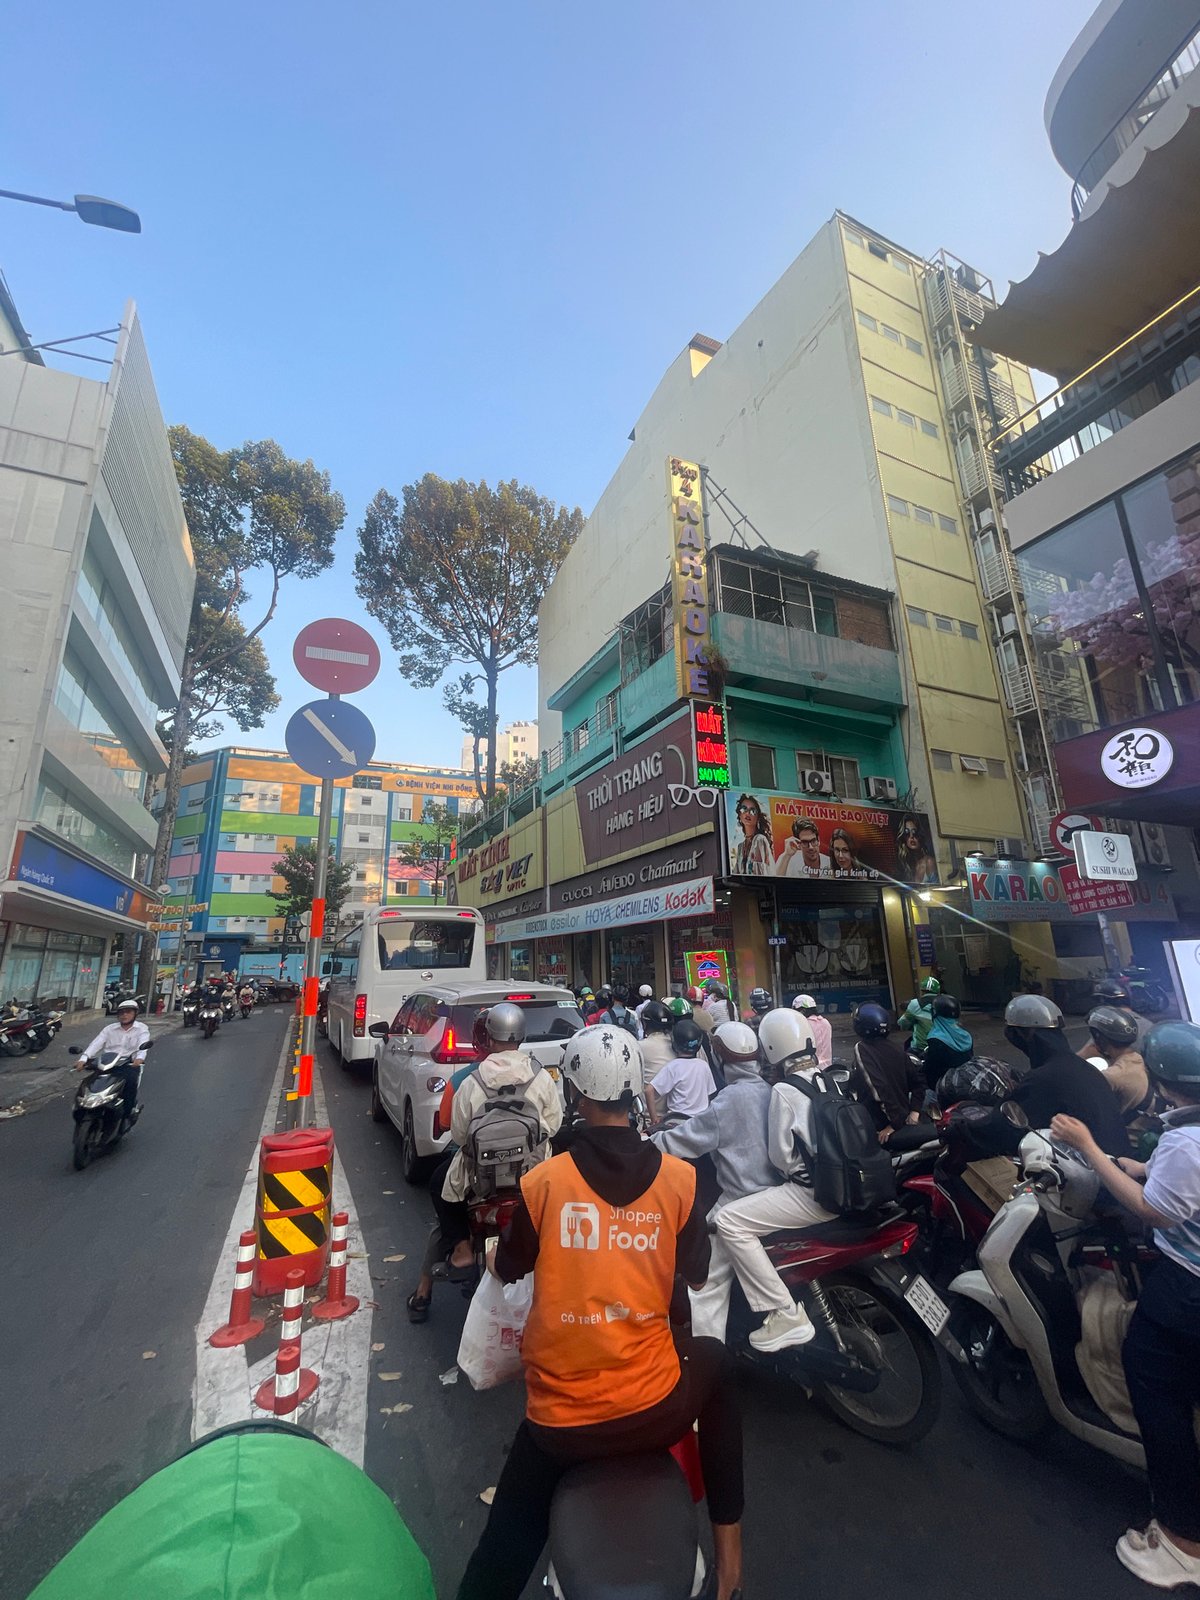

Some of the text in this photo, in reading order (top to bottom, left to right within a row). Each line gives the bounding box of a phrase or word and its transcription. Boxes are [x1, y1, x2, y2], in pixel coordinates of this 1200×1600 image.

[676, 496, 711, 697] KARAOKE
[697, 706, 722, 735] MẮT
[614, 751, 663, 796] TRANG
[443, 783, 454, 791] NHI
[606, 793, 664, 835] HÀNG HIỆU
[806, 804, 838, 820] KÍNH
[840, 809, 862, 822] SAO
[864, 812, 889, 828] VIỆT
[480, 835, 510, 873] KÍNH
[1092, 865, 1135, 876] SUSHI WAGAO
[507, 880, 527, 892] OPTIC
[562, 886, 593, 903] GUCCI
[550, 914, 580, 931] essilor
[585, 905, 612, 926] HOYA
[615, 896, 660, 920] CHEMILENS
[664, 885, 708, 912] Kodak
[609, 1205, 662, 1227] Shopee
[608, 1225, 660, 1252] Food
[560, 1311, 575, 1324] CÓ
